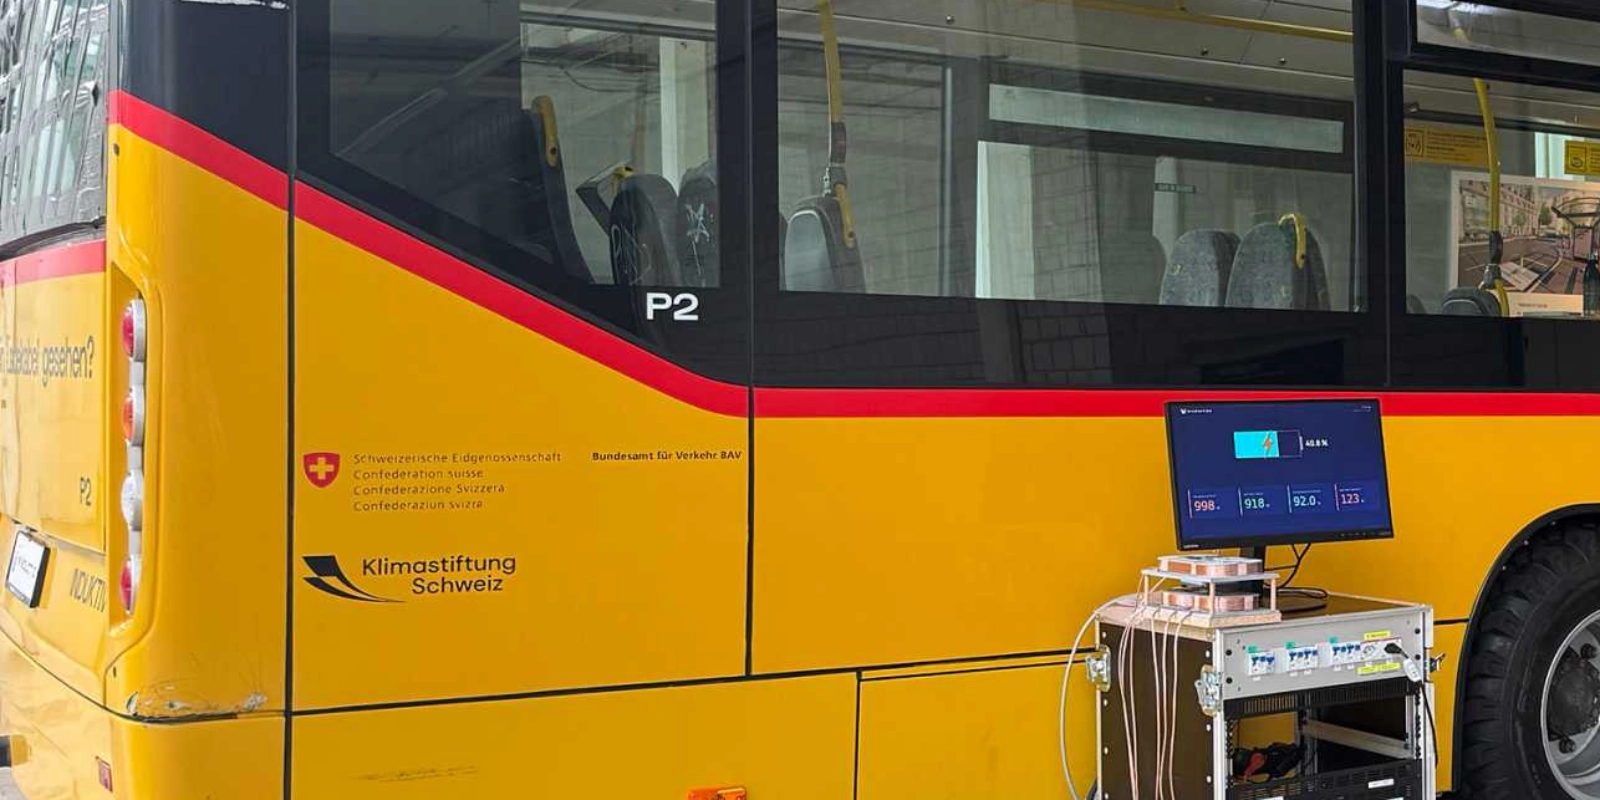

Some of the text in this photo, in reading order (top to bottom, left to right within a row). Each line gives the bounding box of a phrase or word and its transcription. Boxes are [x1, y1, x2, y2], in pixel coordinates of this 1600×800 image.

[647, 292, 699, 320] P2
[354, 451, 561, 464] Schweizerische Eidgenossenschaft
[592, 451, 741, 461] Bundesamt für Verkehr BAV
[80, 477, 92, 506] P2
[353, 483, 505, 496] Confederazione Svizzera
[1194, 500, 1215, 511] 998
[1244, 498, 1265, 509] 918
[1293, 495, 1316, 507] 92.0
[1340, 493, 1360, 505] 123
[362, 555, 516, 576] Klimastiftung
[412, 575, 503, 595] Schweiz
